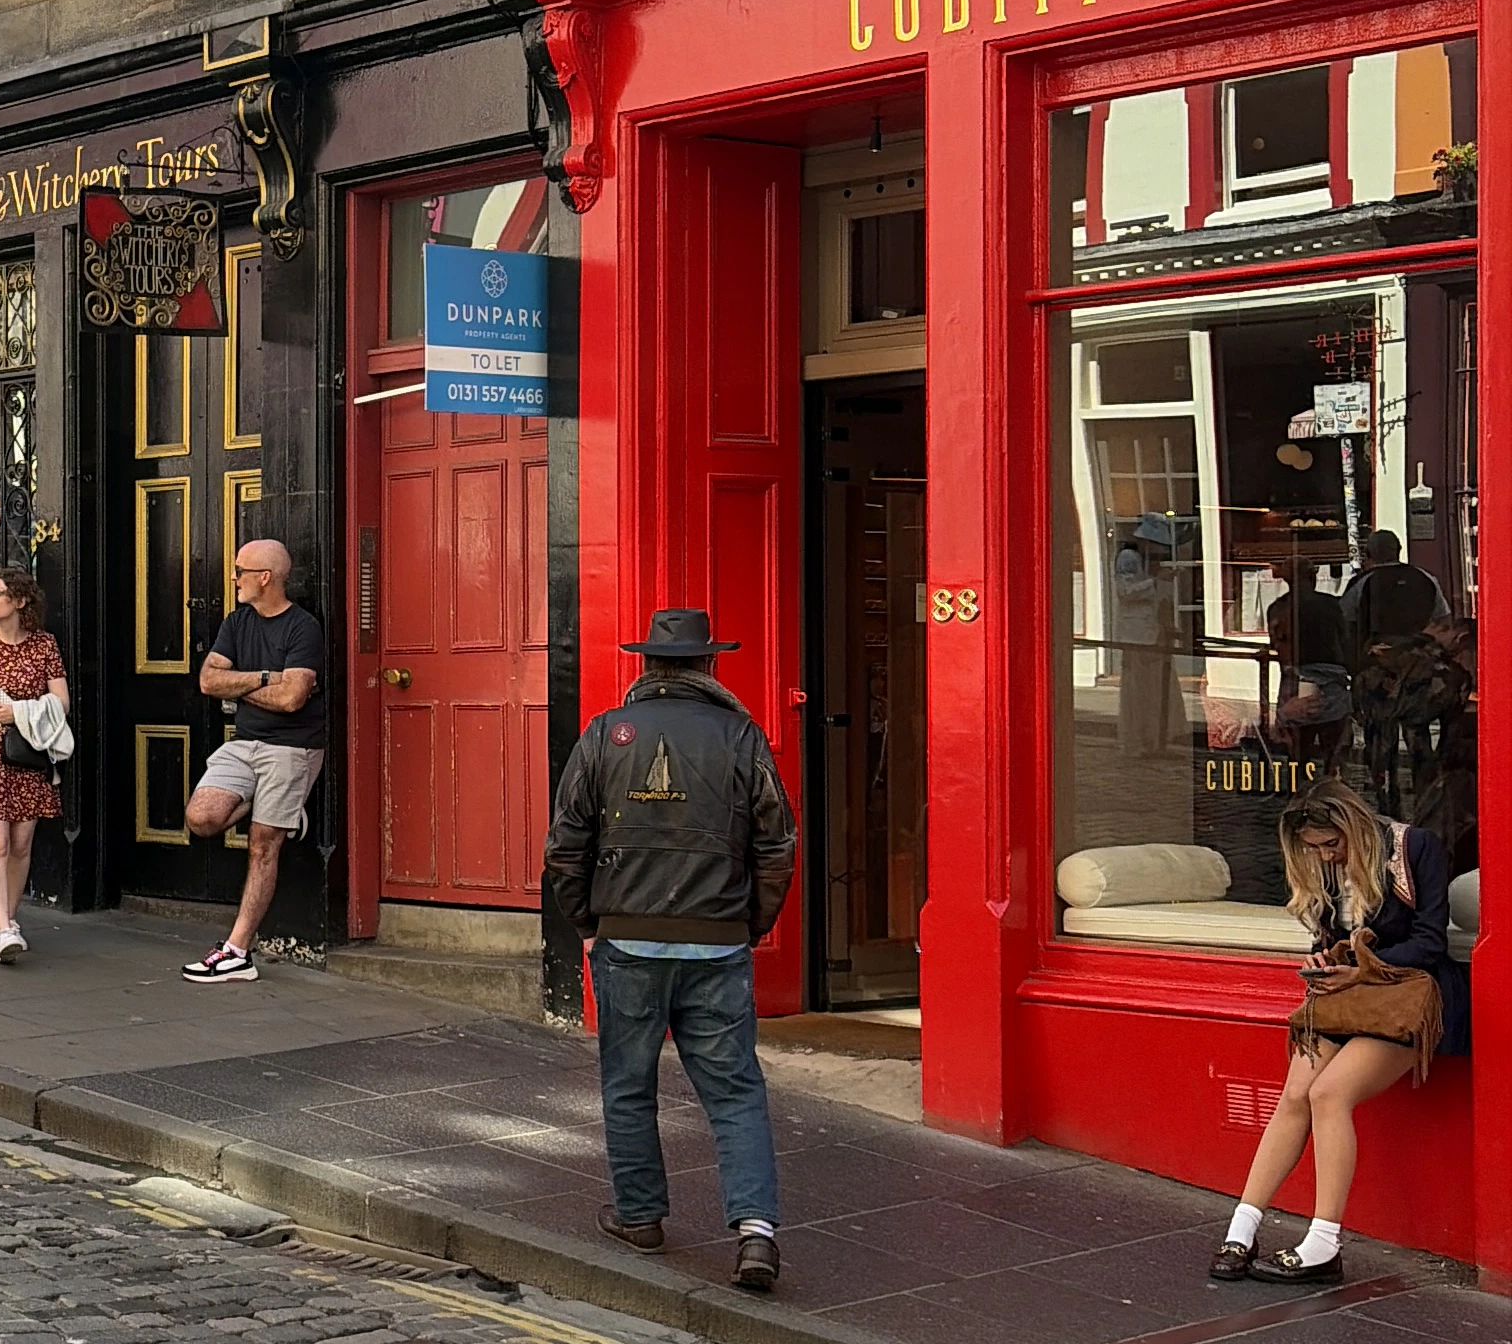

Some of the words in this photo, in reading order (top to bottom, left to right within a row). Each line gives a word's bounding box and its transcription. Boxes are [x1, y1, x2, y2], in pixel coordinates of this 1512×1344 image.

[6, 146, 130, 217] Witchery
[136, 137, 219, 189] Tours
[134, 225, 163, 238] THE
[118, 236, 182, 268] WITCHERY
[124, 265, 174, 295] TOURS
[447, 303, 543, 328] DUNPARK
[464, 330, 499, 339] PROPERTY
[501, 333, 526, 341] AGENTS
[471, 353, 491, 369] TO
[496, 355, 521, 371] LET
[447, 383, 478, 401] 0131
[482, 386, 506, 402] 557
[509, 388, 543, 405] 4466
[35, 517, 62, 543] 84
[932, 588, 979, 623] 88
